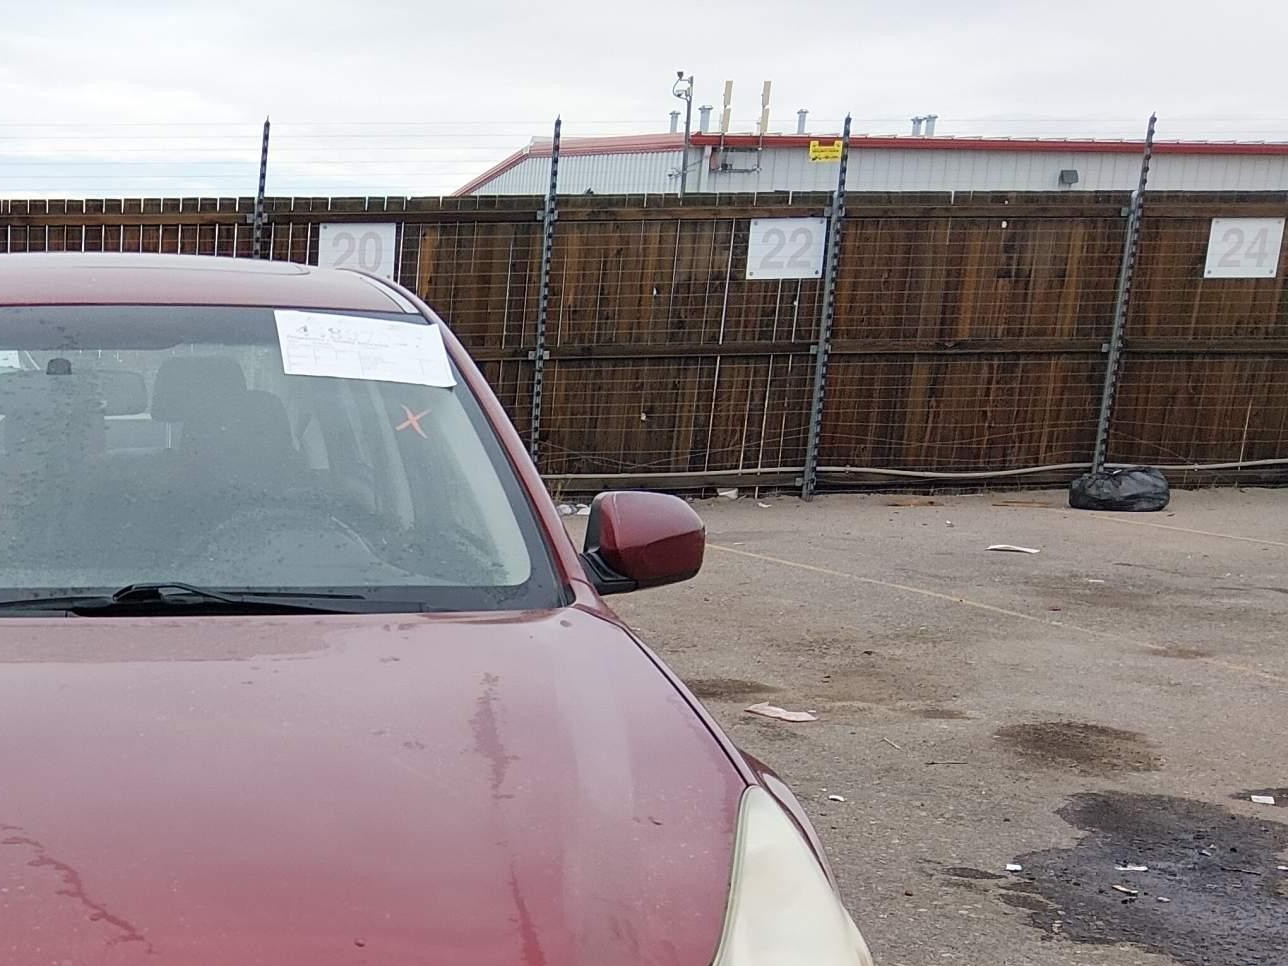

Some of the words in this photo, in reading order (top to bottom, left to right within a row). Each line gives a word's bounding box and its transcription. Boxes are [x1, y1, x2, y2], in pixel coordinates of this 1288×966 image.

[332, 232, 383, 273] 20
[759, 227, 812, 269] 22
[1217, 227, 1269, 268] 24
